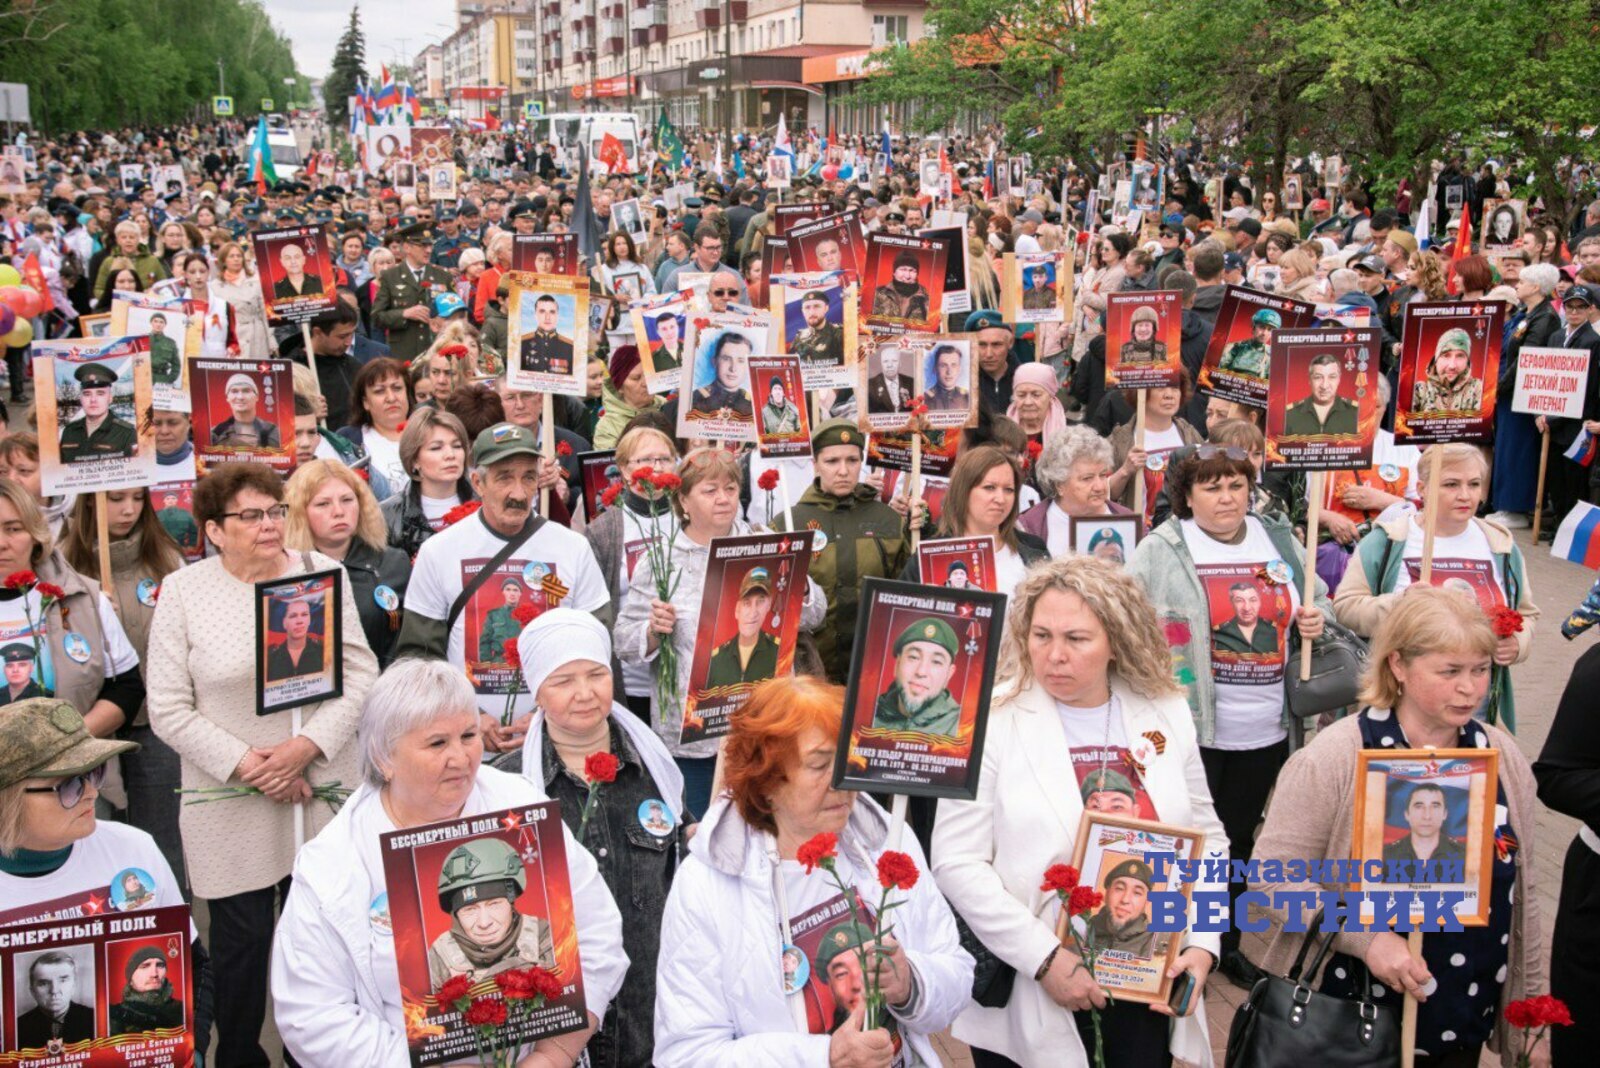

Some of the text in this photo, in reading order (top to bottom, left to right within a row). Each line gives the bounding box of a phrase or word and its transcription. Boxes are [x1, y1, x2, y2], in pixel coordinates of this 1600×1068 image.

[1519, 353, 1588, 372] СЕРАФИМОВСКИЙ
[1522, 373, 1578, 393] ДЕТСКИЙ ДОМ
[1528, 394, 1568, 413] ИНТЕРНАТ
[936, 600, 956, 613] ПОЛК
[975, 605, 992, 618] СВО
[895, 742, 929, 752] рядовой
[390, 807, 548, 850] БЕССМЕРТНЫЙ ПОЛК СВО
[110, 915, 157, 934] ПОЛК
[1101, 950, 1133, 961] АНИЕВ
